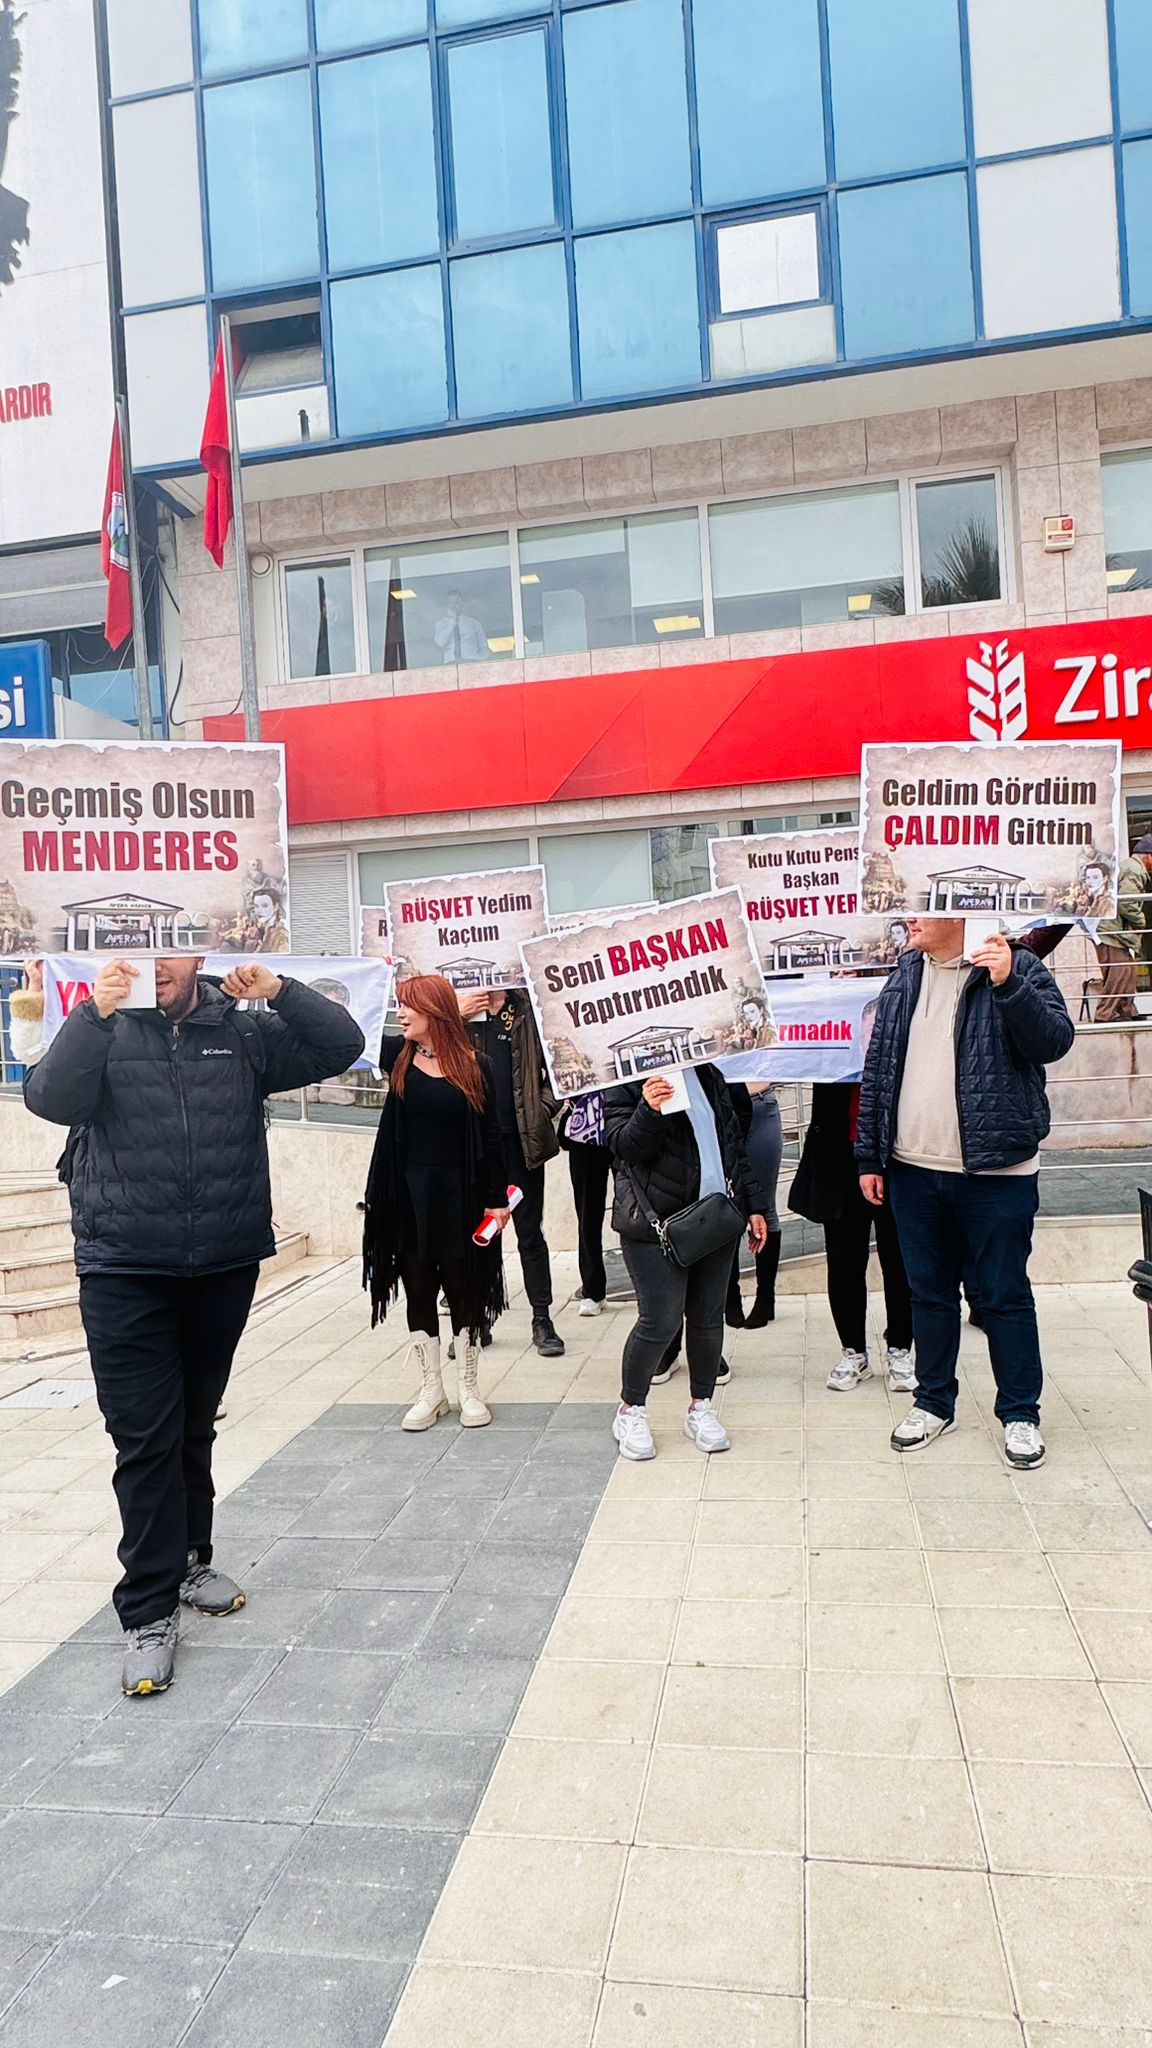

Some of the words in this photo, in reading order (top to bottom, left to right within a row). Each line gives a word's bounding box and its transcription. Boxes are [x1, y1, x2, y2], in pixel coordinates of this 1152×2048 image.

[1053, 653, 1152, 724] Zir
[1, 780, 143, 826] Geçmiş
[152, 782, 256, 819] Olsun
[882, 778, 979, 806] Geldim
[986, 776, 1097, 806] Gördüm
[22, 830, 239, 872] MENDERES
[884, 815, 1000, 852] ÇALDIM
[1007, 817, 1093, 845] Gittim
[748, 853, 782, 869] Kutu
[786, 850, 821, 866] Kutu
[783, 871, 839, 891] Başkan
[401, 896, 474, 925] RÜŞVET
[477, 892, 533, 915] Yedim
[746, 896, 820, 923] RÜŞVET
[438, 924, 500, 948] Kaçtım
[544, 954, 606, 993] Seni
[607, 918, 729, 977] BAŞKAN
[565, 965, 728, 1029] Yaptırmadık
